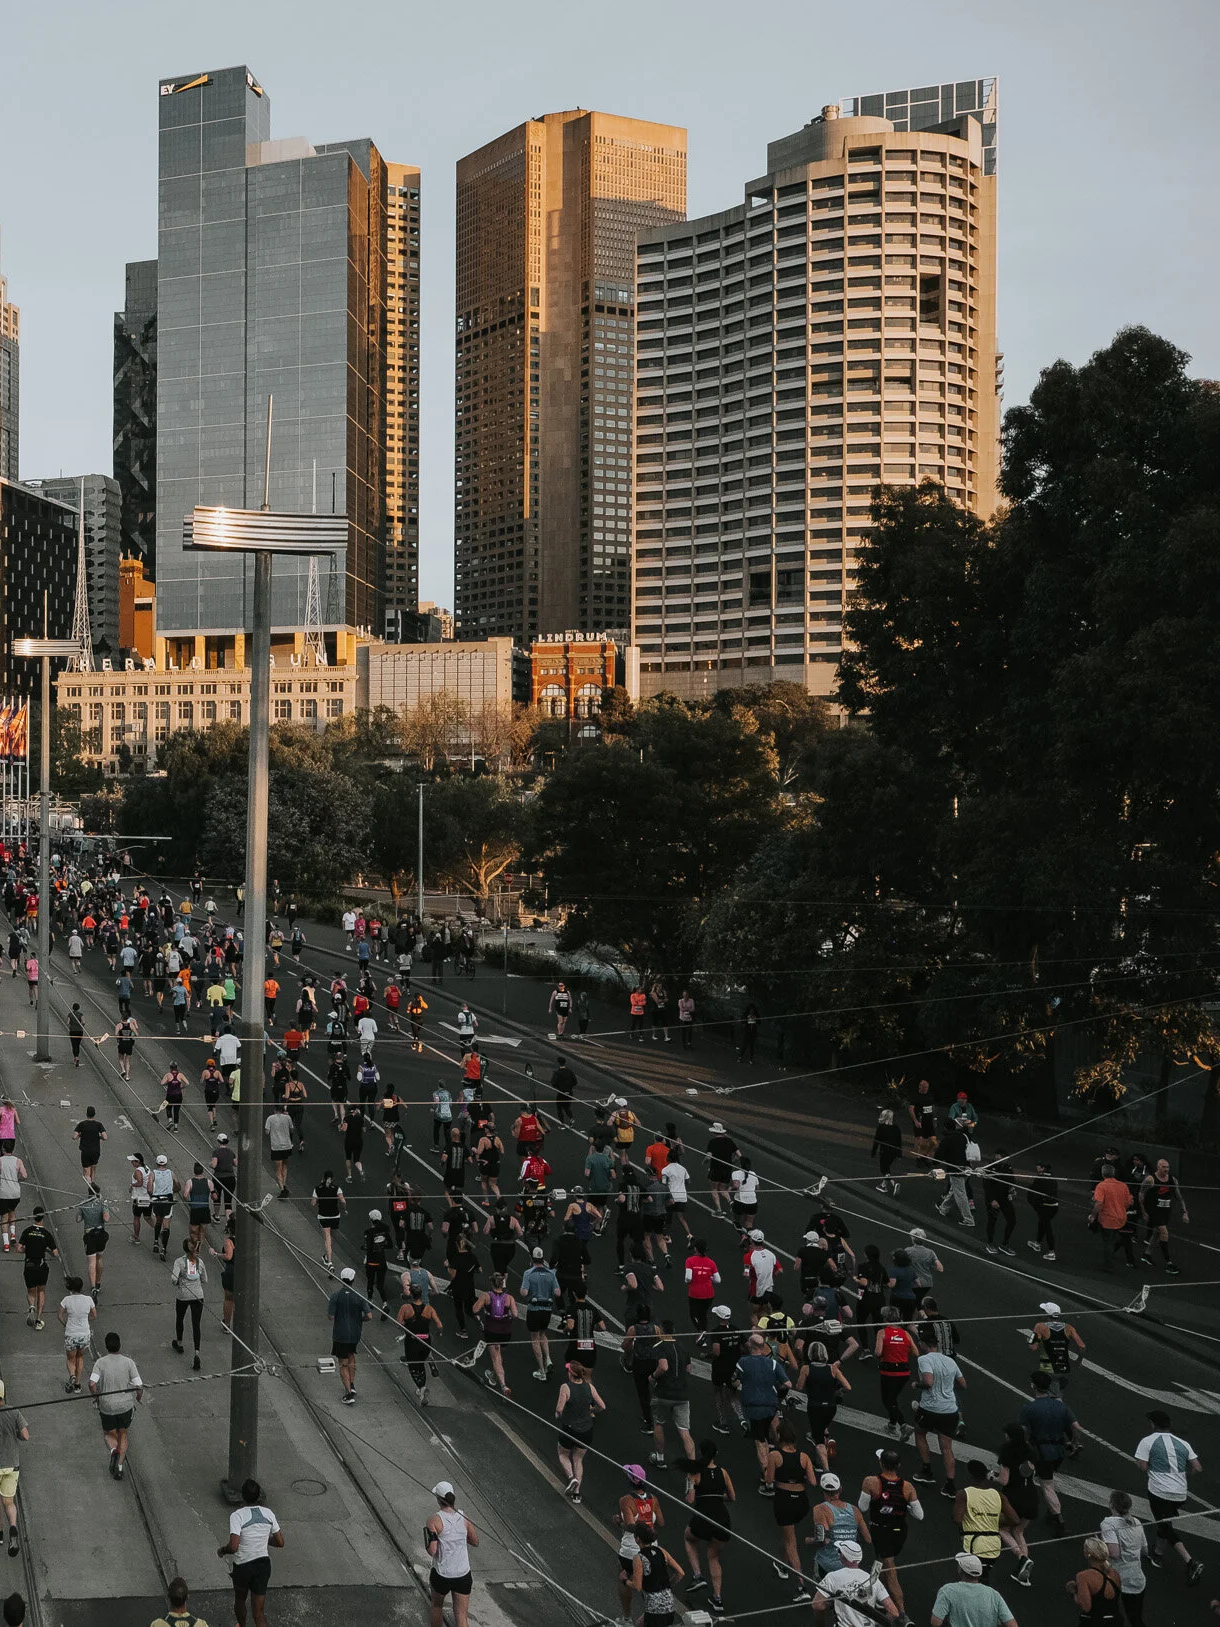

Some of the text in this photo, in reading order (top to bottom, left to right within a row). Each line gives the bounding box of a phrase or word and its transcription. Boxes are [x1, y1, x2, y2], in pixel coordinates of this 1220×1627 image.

[161, 83, 175, 96] EY
[538, 632, 607, 643] LINDRUM
[81, 656, 201, 672] HERALD
